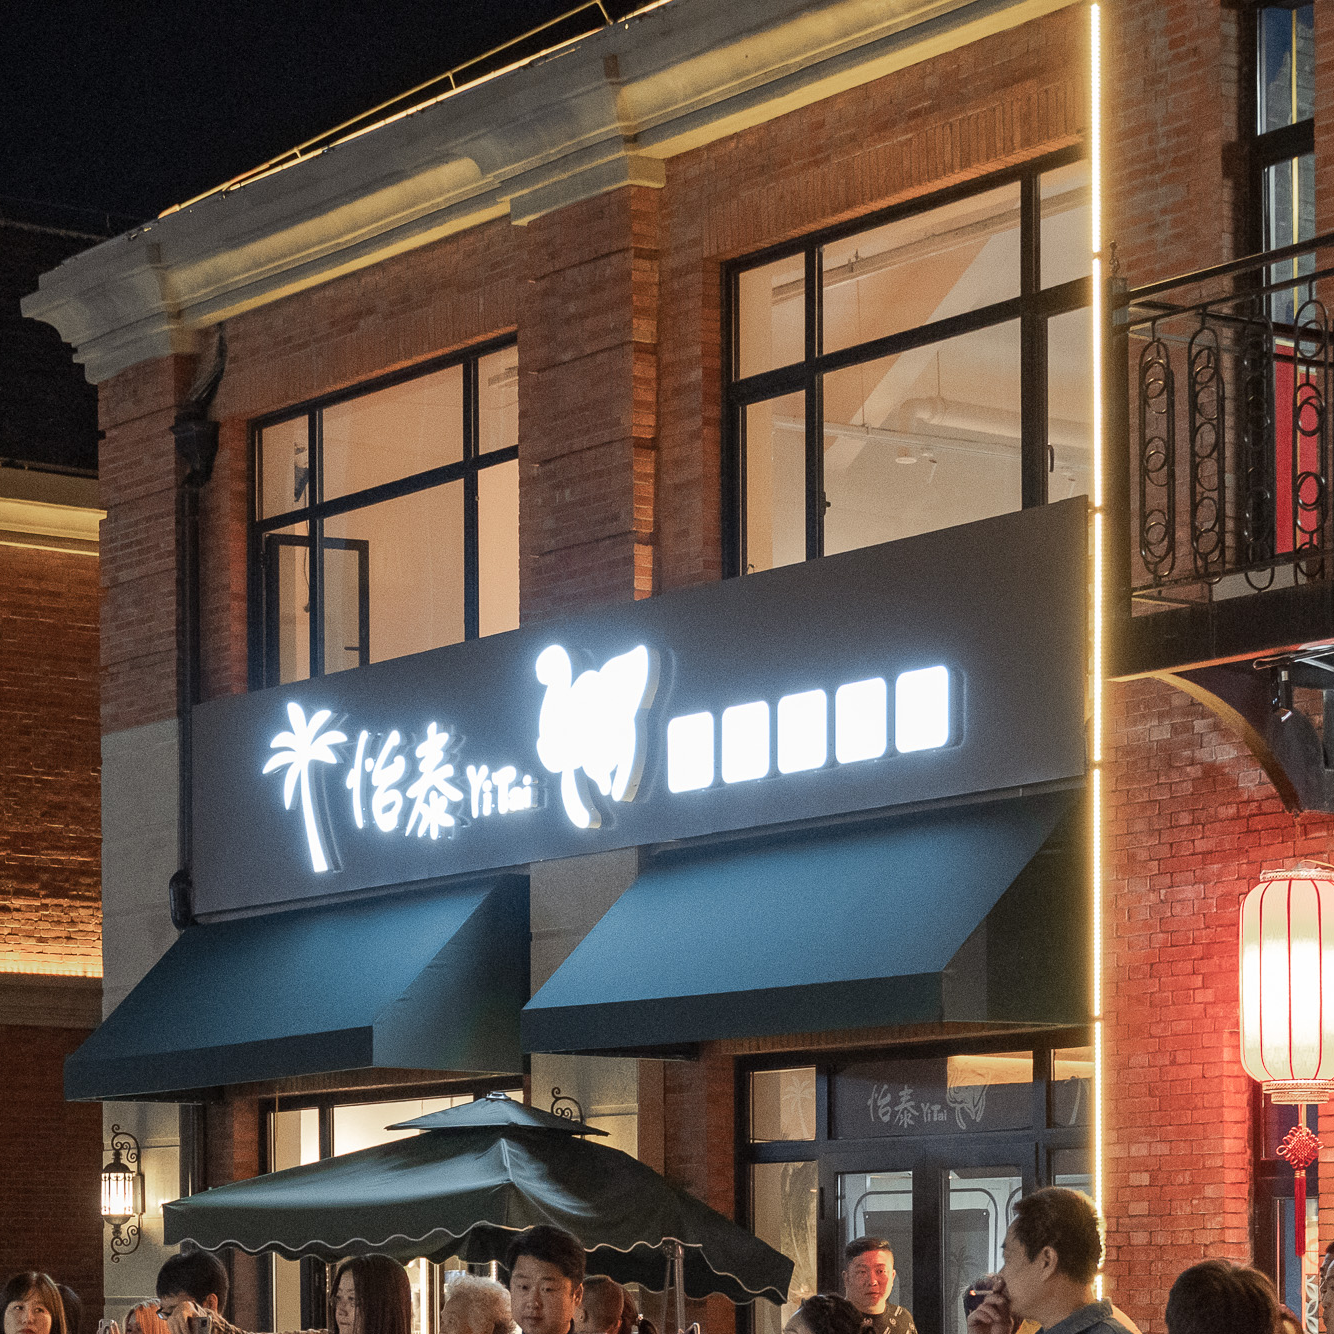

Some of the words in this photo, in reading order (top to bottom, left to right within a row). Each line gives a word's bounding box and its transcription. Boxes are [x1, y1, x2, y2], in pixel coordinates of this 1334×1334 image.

[346, 721, 464, 840] 怡泰
[467, 764, 533, 818] YiTai
[867, 1084, 919, 1129] 怡泰
